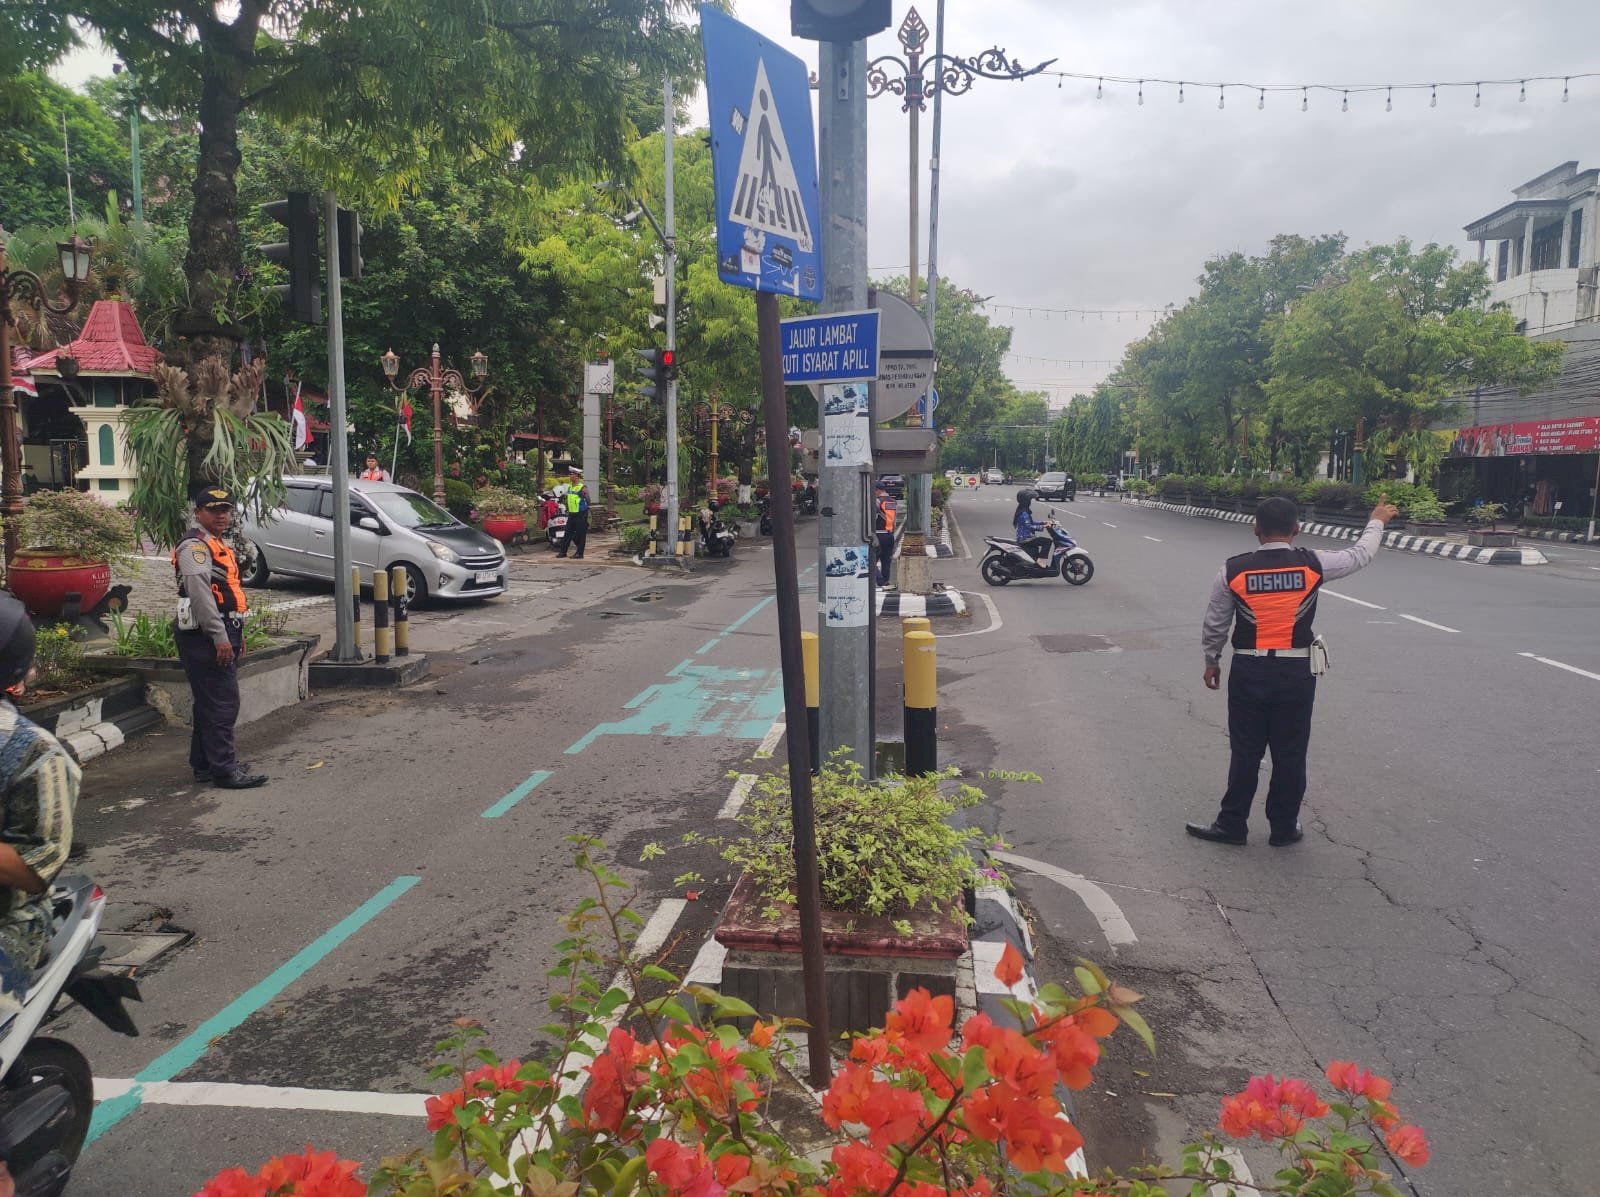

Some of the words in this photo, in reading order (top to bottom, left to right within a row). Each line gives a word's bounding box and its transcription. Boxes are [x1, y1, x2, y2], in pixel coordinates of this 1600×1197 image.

[789, 328, 816, 349] JALUR
[820, 323, 858, 346] LAMBAT
[803, 351, 839, 373] ISYARAT
[842, 348, 869, 370] APILL
[1248, 573, 1303, 591] DISHUB
